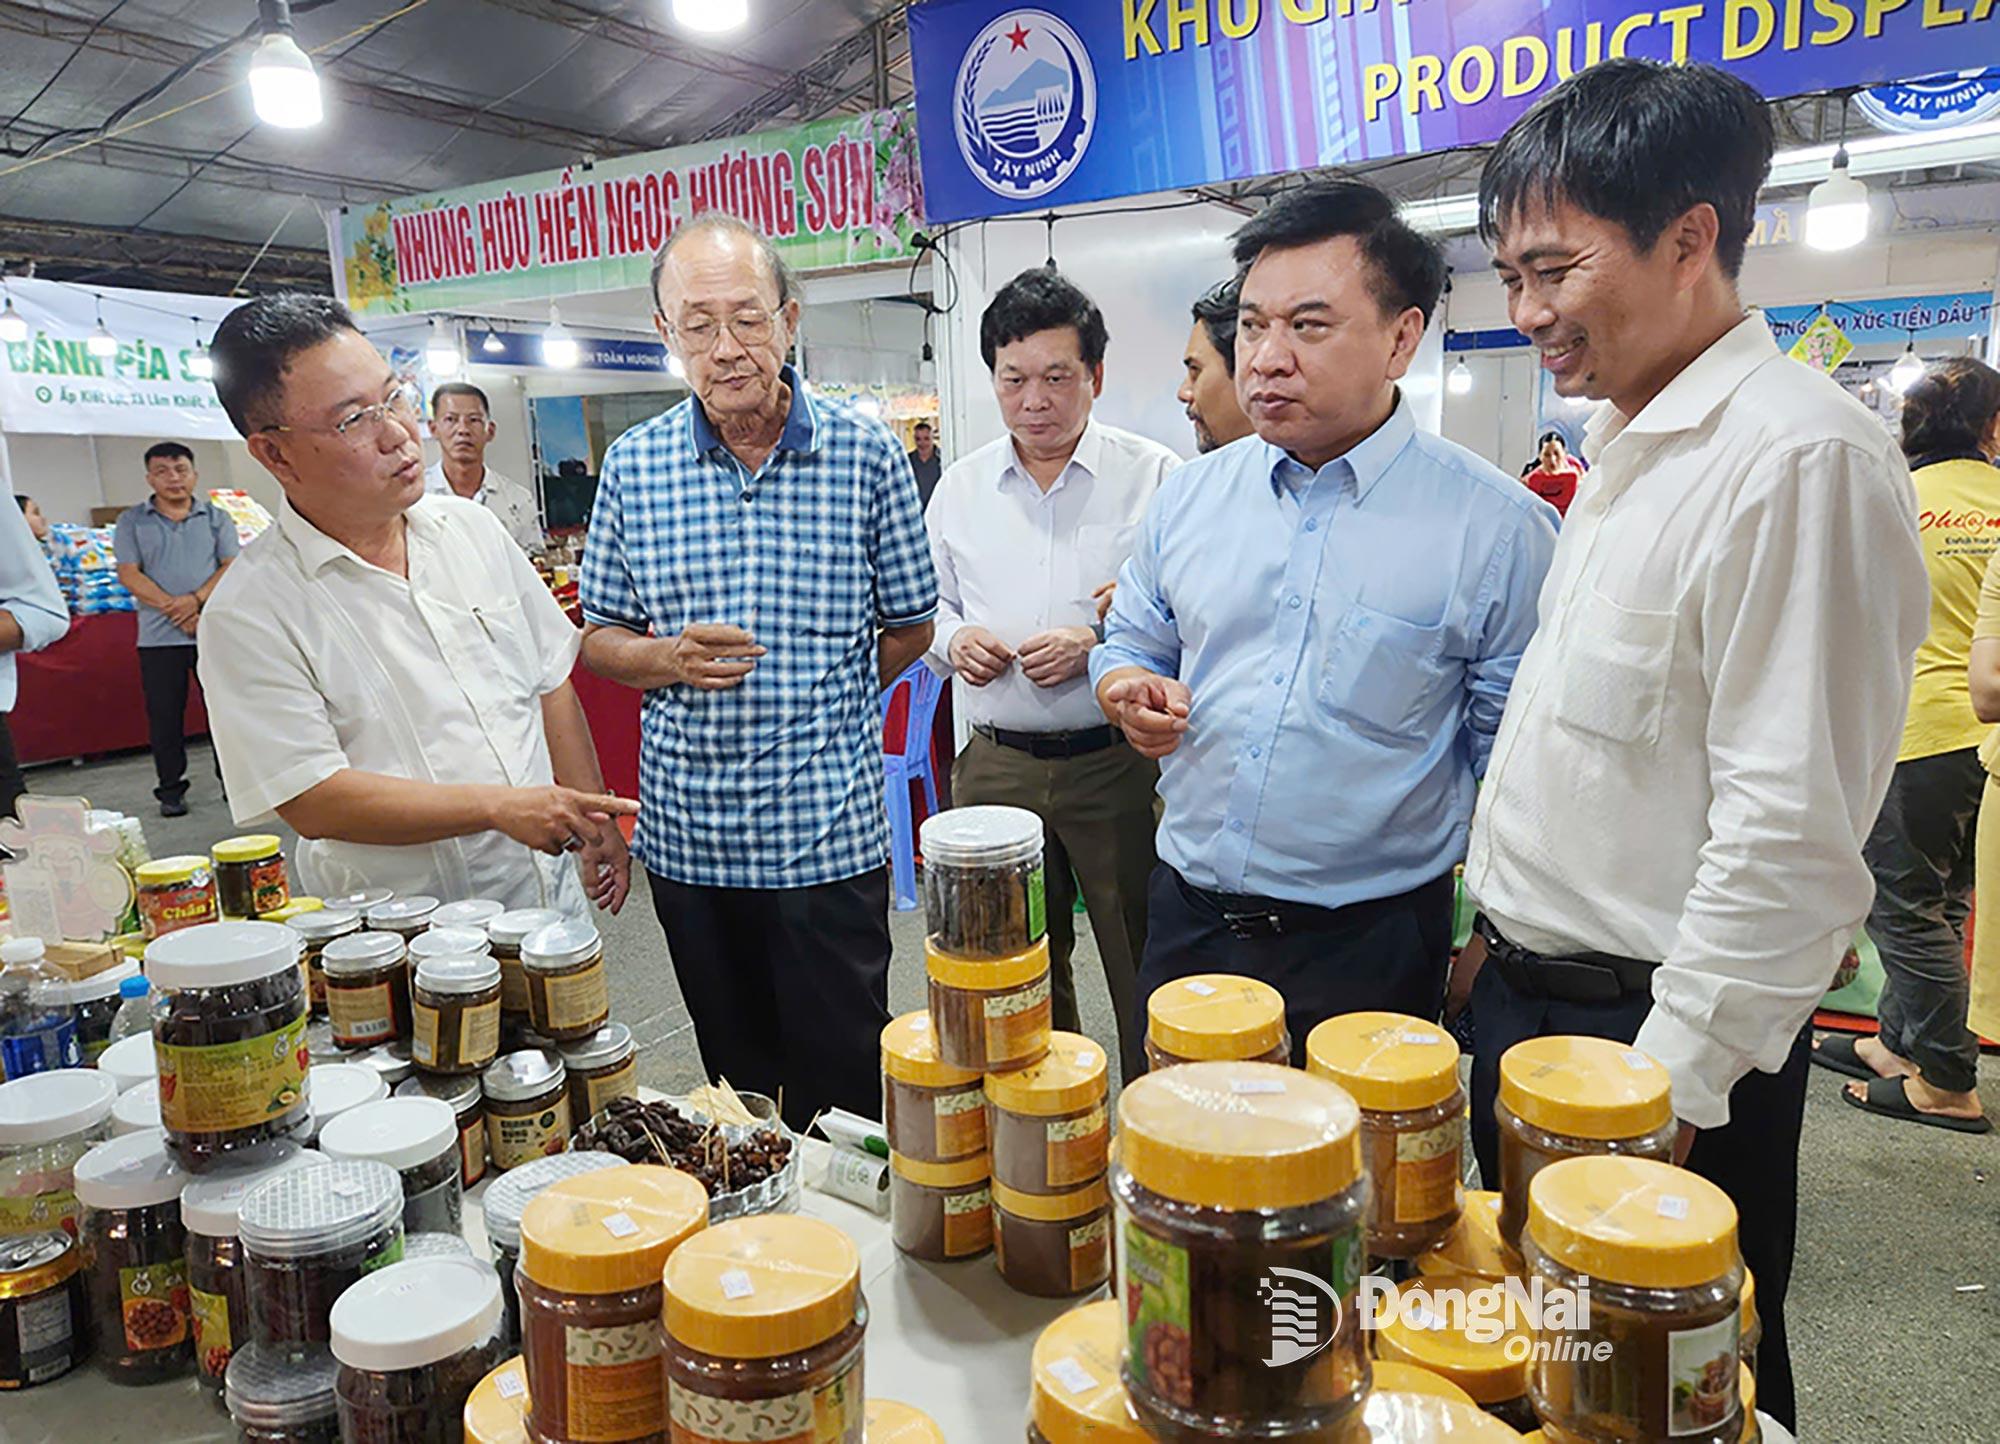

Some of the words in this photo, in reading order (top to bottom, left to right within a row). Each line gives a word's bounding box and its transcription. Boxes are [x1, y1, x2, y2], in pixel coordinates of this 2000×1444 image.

[1363, 4, 1704, 121] PRODUCT
[1935, 82, 1985, 109] NINH
[1024, 148, 1061, 177] NINH
[393, 205, 477, 284] NHUNG
[804, 133, 874, 232] SƠN
